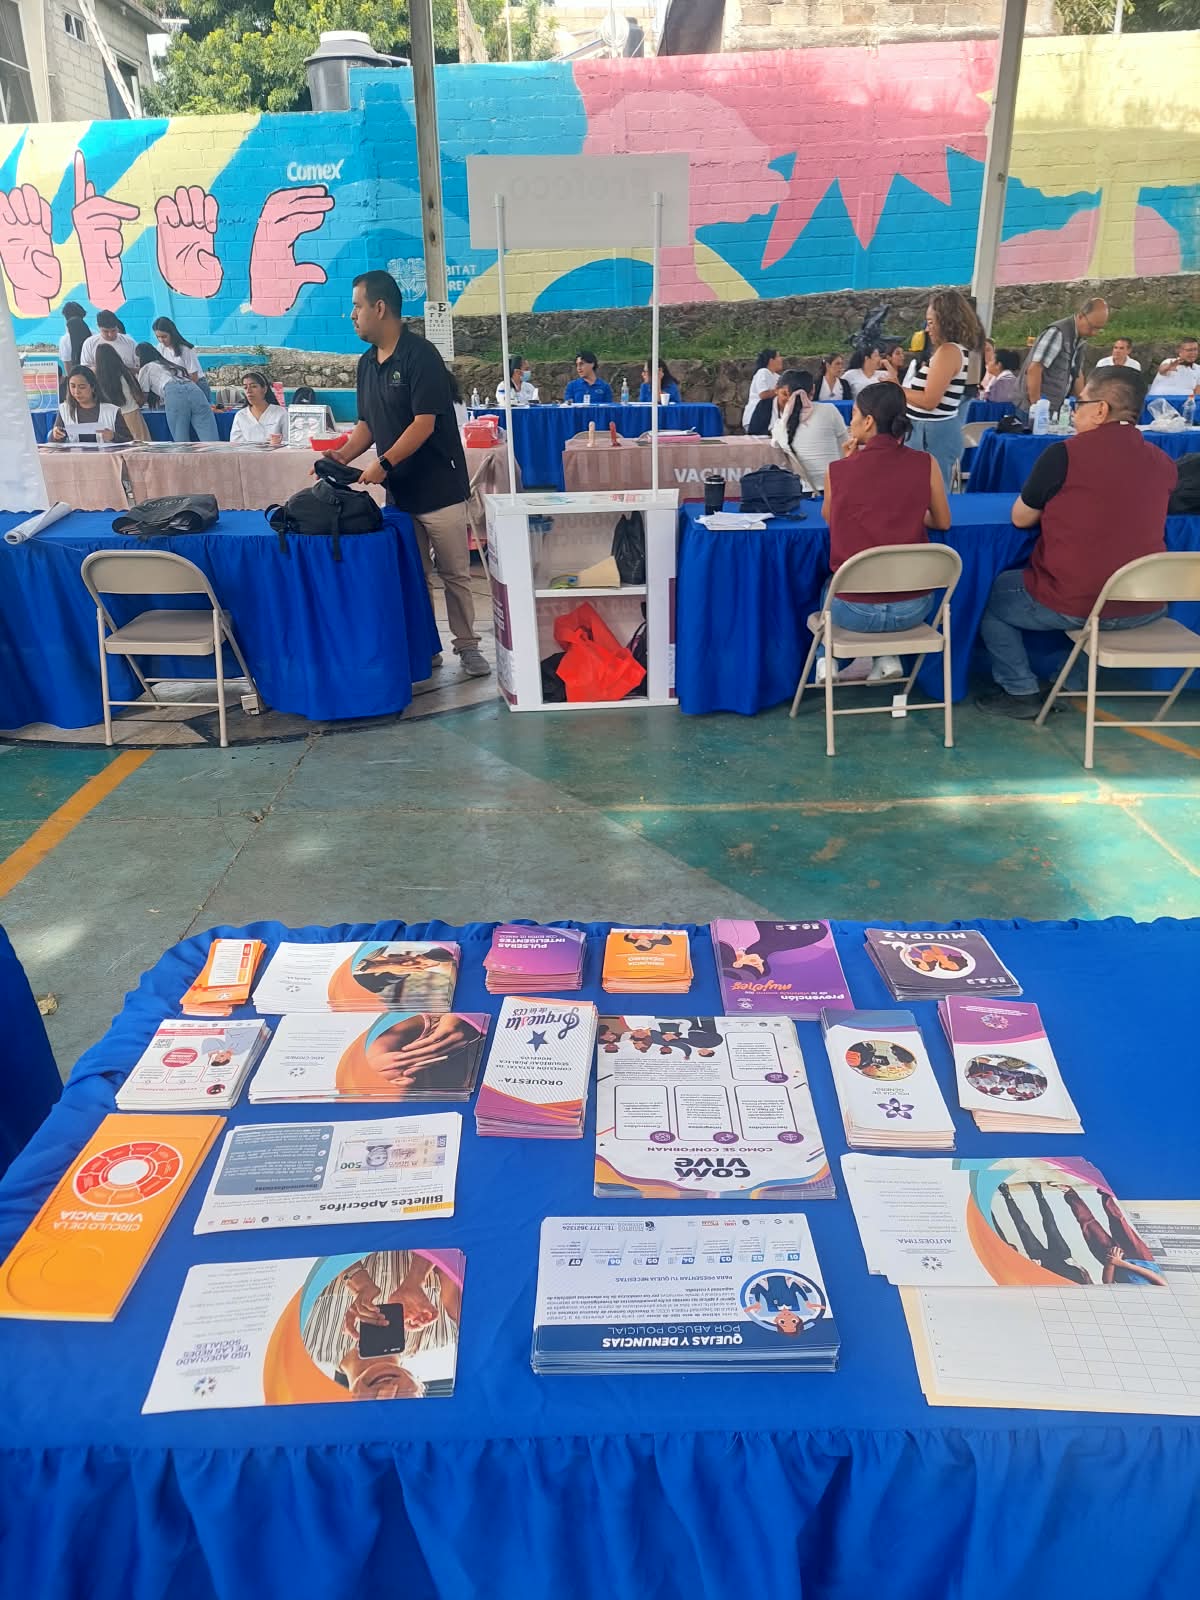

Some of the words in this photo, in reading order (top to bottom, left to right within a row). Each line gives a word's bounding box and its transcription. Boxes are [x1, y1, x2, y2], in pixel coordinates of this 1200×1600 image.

[287, 158, 344, 181] Comex
[446, 264, 476, 275] BITAT
[438, 303, 446, 312] E
[882, 931, 967, 939] MUCPAZ
[731, 980, 792, 991] mujeres
[512, 1008, 528, 1016] CES
[504, 1078, 563, 1086] ORQUESTA
[340, 1161, 363, 1170] 500
[391, 1194, 444, 1208] Billetes
[319, 1200, 388, 1213] Apócrifos
[60, 1210, 143, 1222] VIOLENCIA
[53, 1221, 69, 1229] LA
[69, 1222, 87, 1230] DE
[89, 1223, 140, 1232] CÍRCULO
[608, 1326, 663, 1336] POLICIAL
[668, 1325, 708, 1335] ABUSO
[714, 1325, 740, 1335] POR
[602, 1336, 679, 1348] DENUNCIAS
[680, 1336, 689, 1347] Y
[692, 1334, 743, 1346] QUEJAS
[183, 1348, 212, 1358] REDES
[214, 1345, 234, 1354] LAS
[234, 1344, 249, 1352] DE
[175, 1353, 228, 1366] ADECUADO
[230, 1351, 251, 1361] USO
